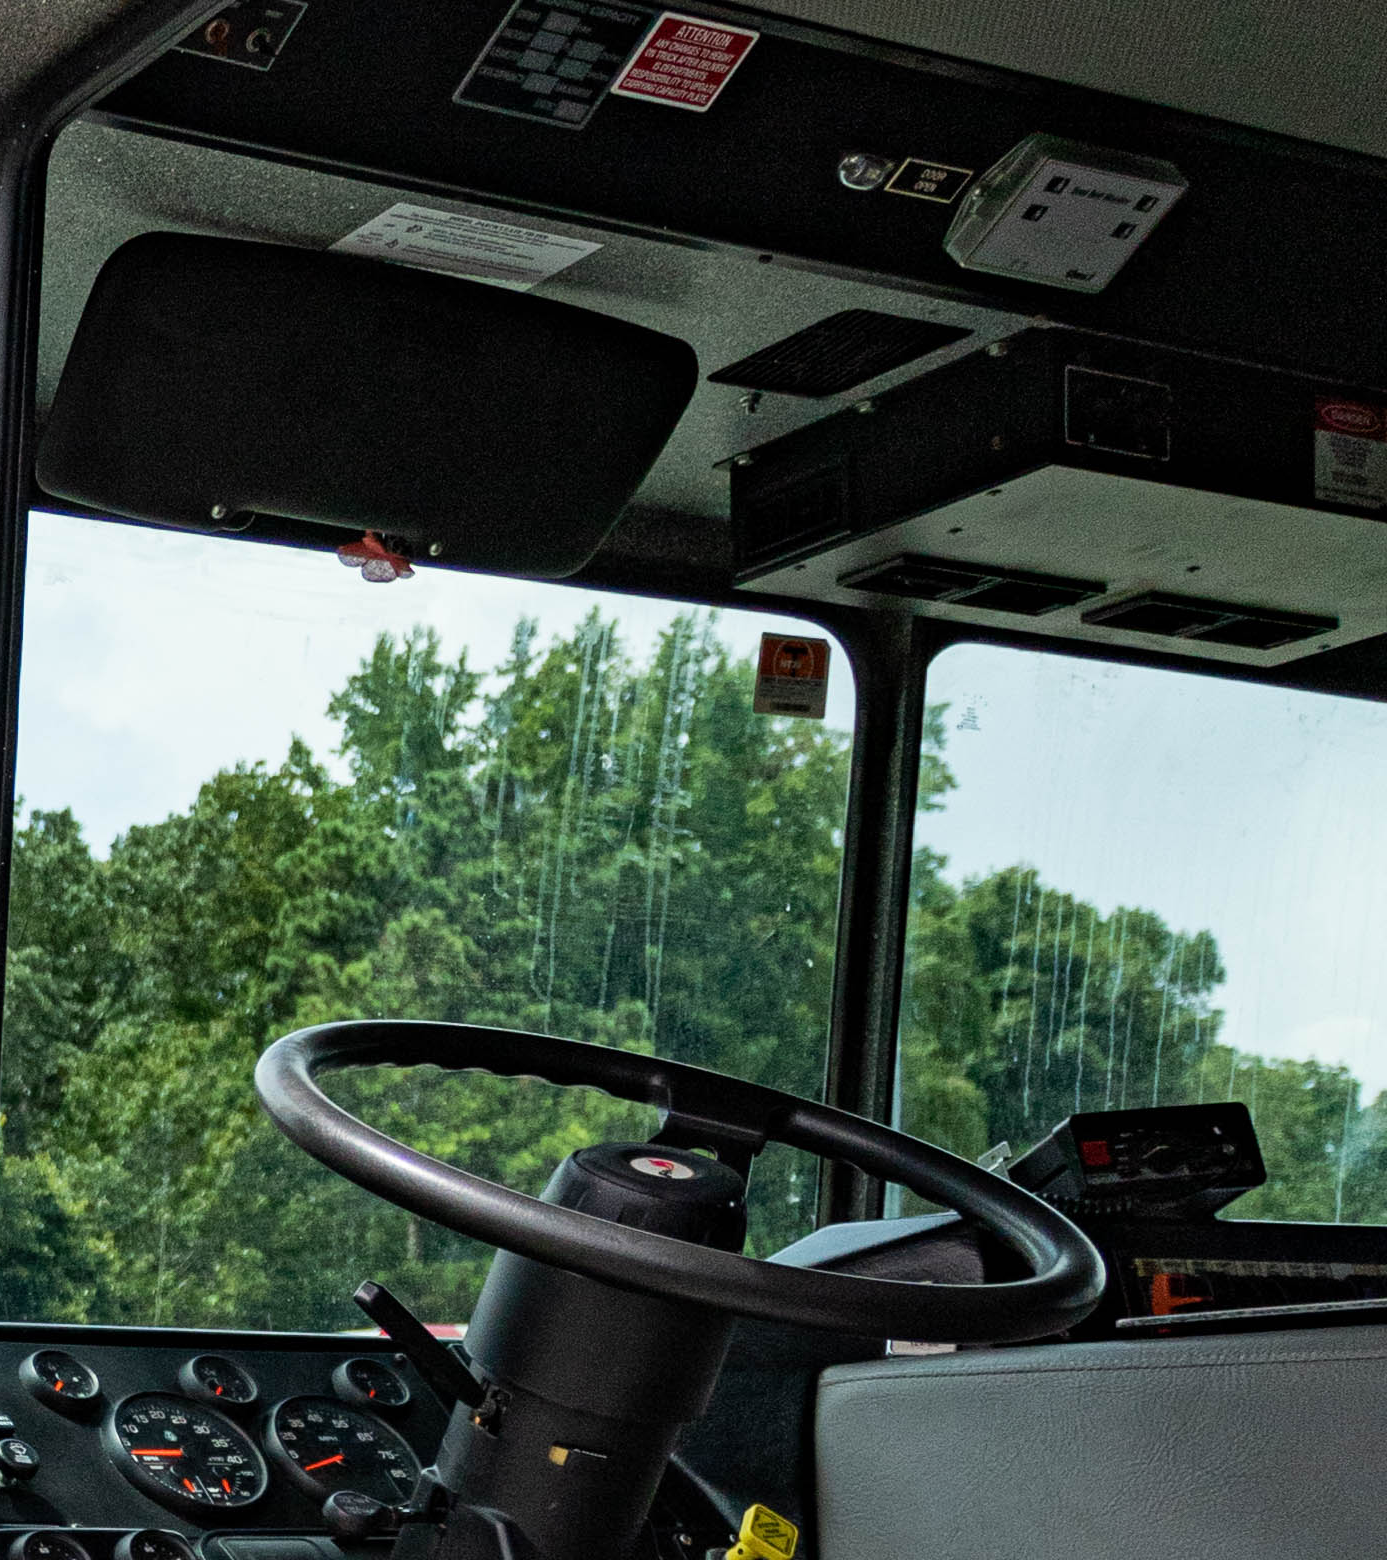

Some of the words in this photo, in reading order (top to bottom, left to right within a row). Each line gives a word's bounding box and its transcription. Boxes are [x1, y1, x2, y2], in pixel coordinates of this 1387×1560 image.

[675, 25, 734, 48] ATTENTION
[668, 41, 701, 55] CHANGES
[656, 50, 677, 62] TRUCK
[677, 55, 699, 67] AFTER
[698, 58, 731, 74] DELIVERY
[654, 85, 687, 99] CAPACITY
[133, 1414, 149, 1424] 15
[148, 1409, 166, 1420] 20
[170, 1414, 188, 1425] 25
[122, 1424, 139, 1434] 10
[193, 1424, 211, 1434] 30
[211, 1438, 229, 1448] 35
[226, 1455, 244, 1465] 40
